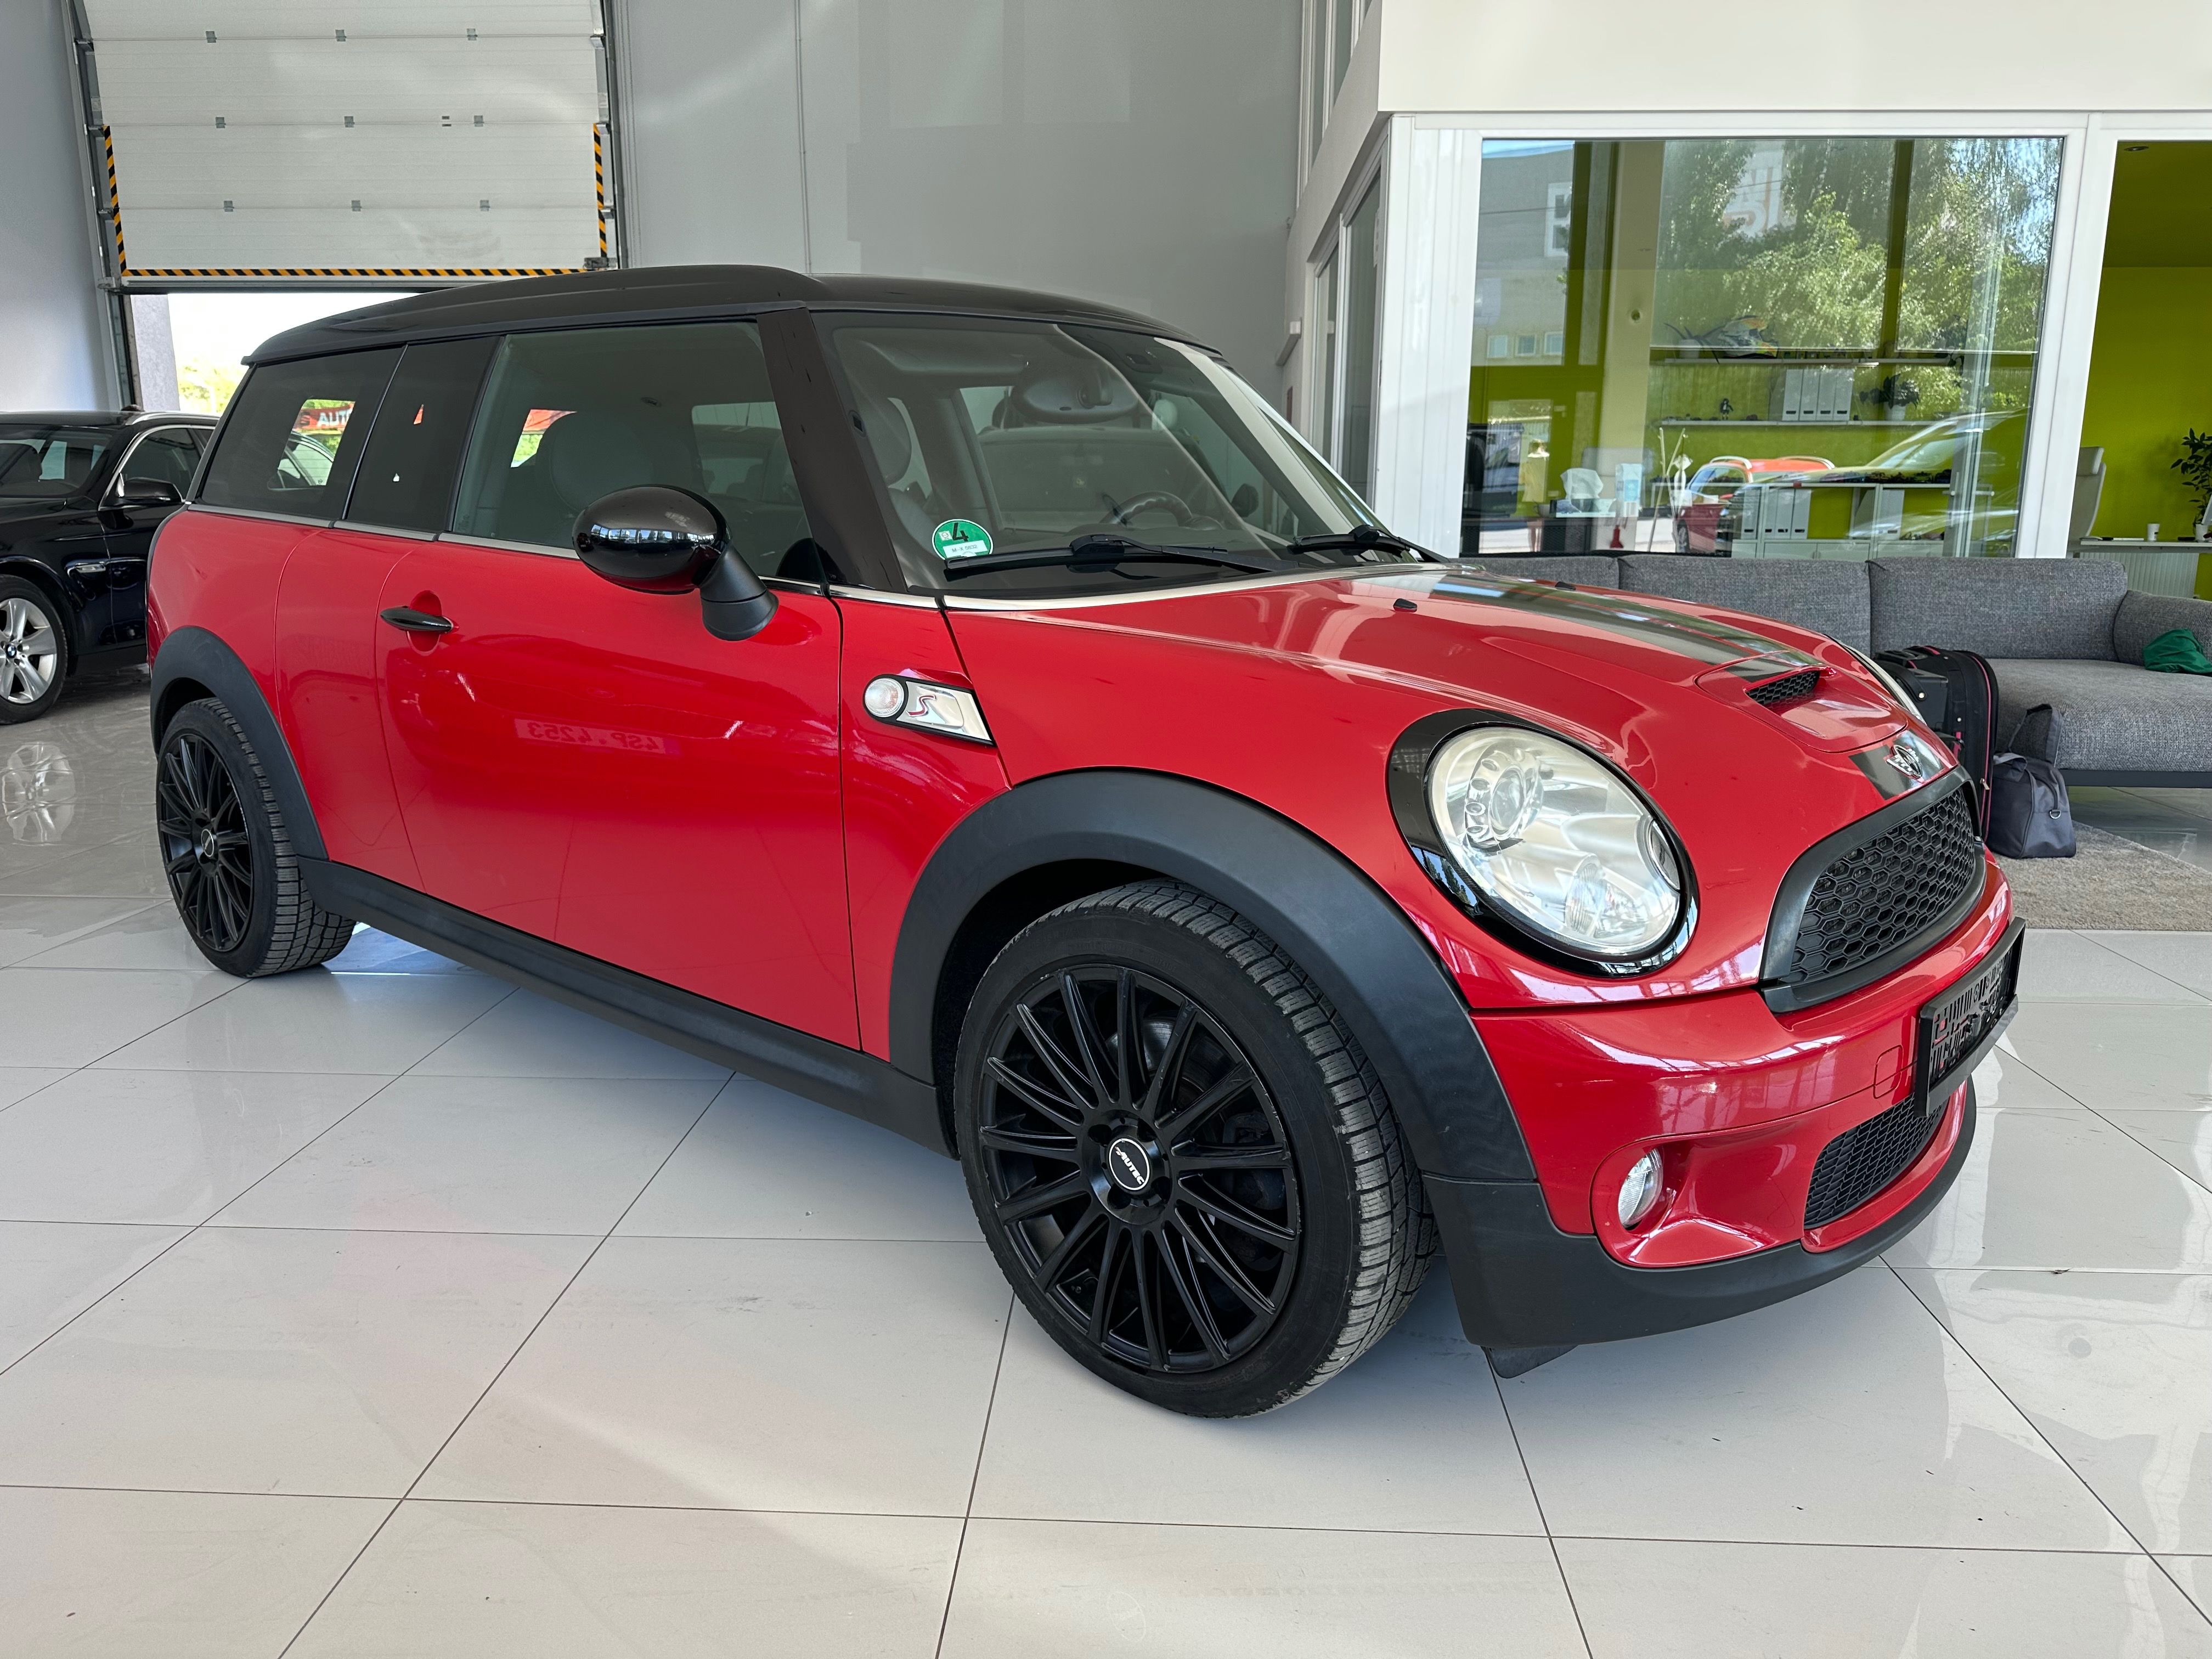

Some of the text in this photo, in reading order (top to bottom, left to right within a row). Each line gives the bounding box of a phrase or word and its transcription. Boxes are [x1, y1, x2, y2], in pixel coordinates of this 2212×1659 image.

[317, 409, 352, 427] AUT
[952, 522, 969, 542] 4
[1114, 1146, 1145, 1185] AUTEC
